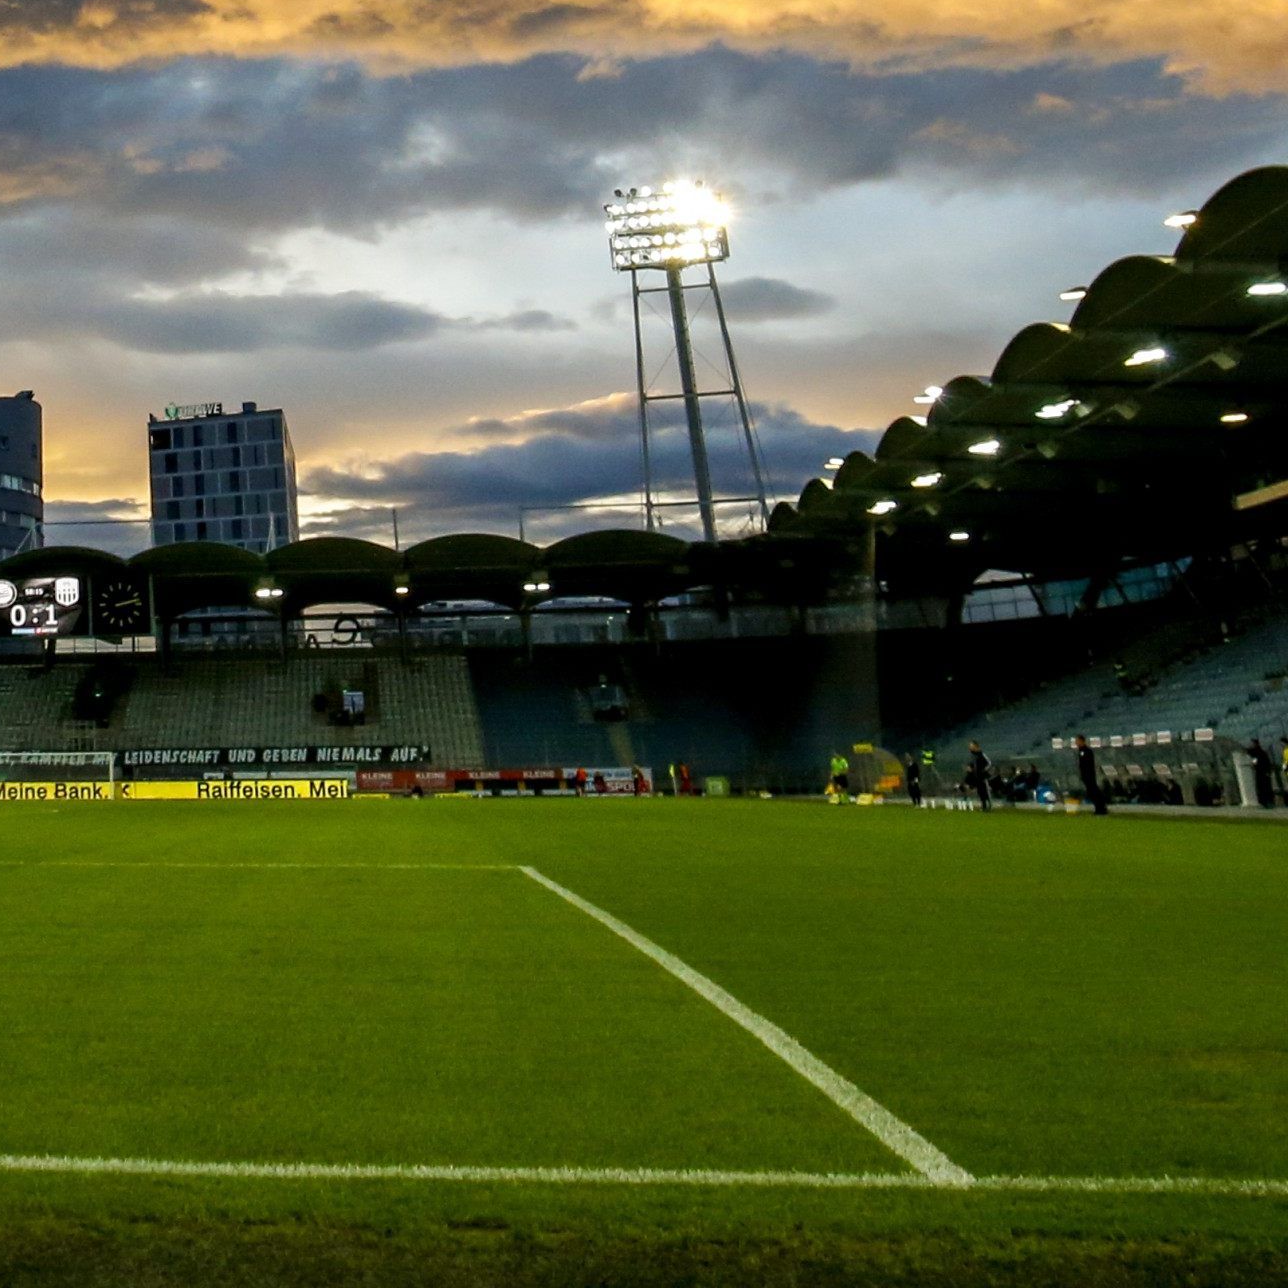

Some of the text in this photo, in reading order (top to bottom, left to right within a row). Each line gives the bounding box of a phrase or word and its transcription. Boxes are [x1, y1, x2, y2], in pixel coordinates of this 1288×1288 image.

[124, 750, 220, 764] LEIDENSCHAFT
[228, 749, 256, 763] UND
[263, 748, 307, 762] GEBEN
[316, 747, 382, 761] NIEMALS
[55, 782, 109, 798] Bank.
[197, 781, 302, 798] Raiffeisen.
[310, 781, 345, 798] Mei
